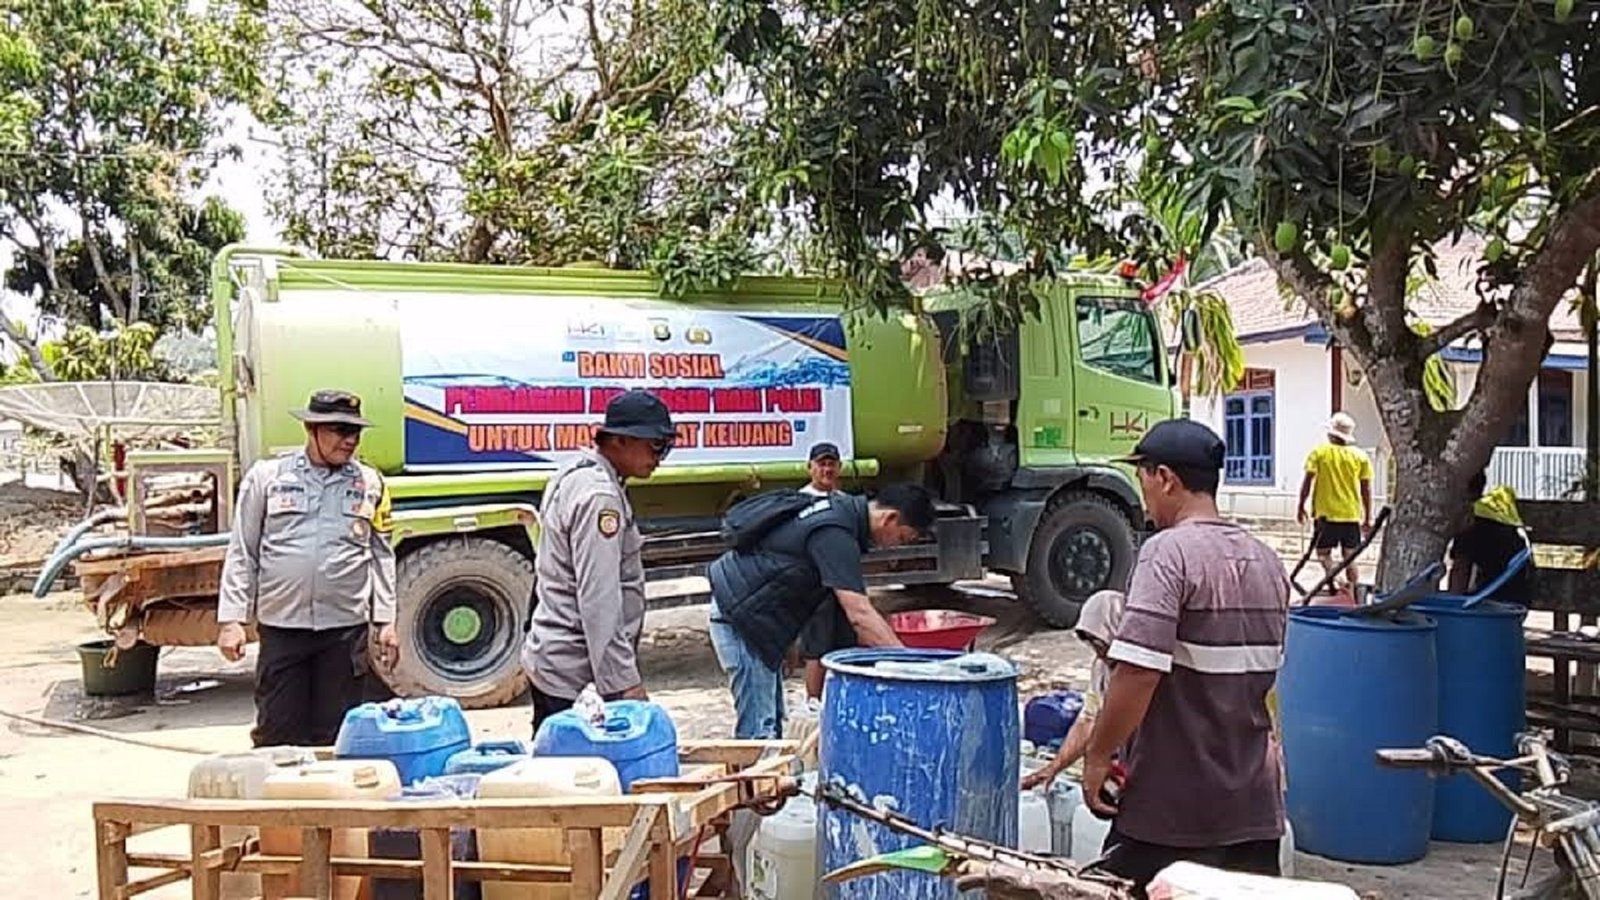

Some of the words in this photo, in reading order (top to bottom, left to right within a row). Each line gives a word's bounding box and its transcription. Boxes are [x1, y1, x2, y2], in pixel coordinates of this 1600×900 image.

[650, 353, 726, 379] SOSIAL
[467, 423, 551, 453] UNTUK
[703, 420, 793, 448] KELUANG
